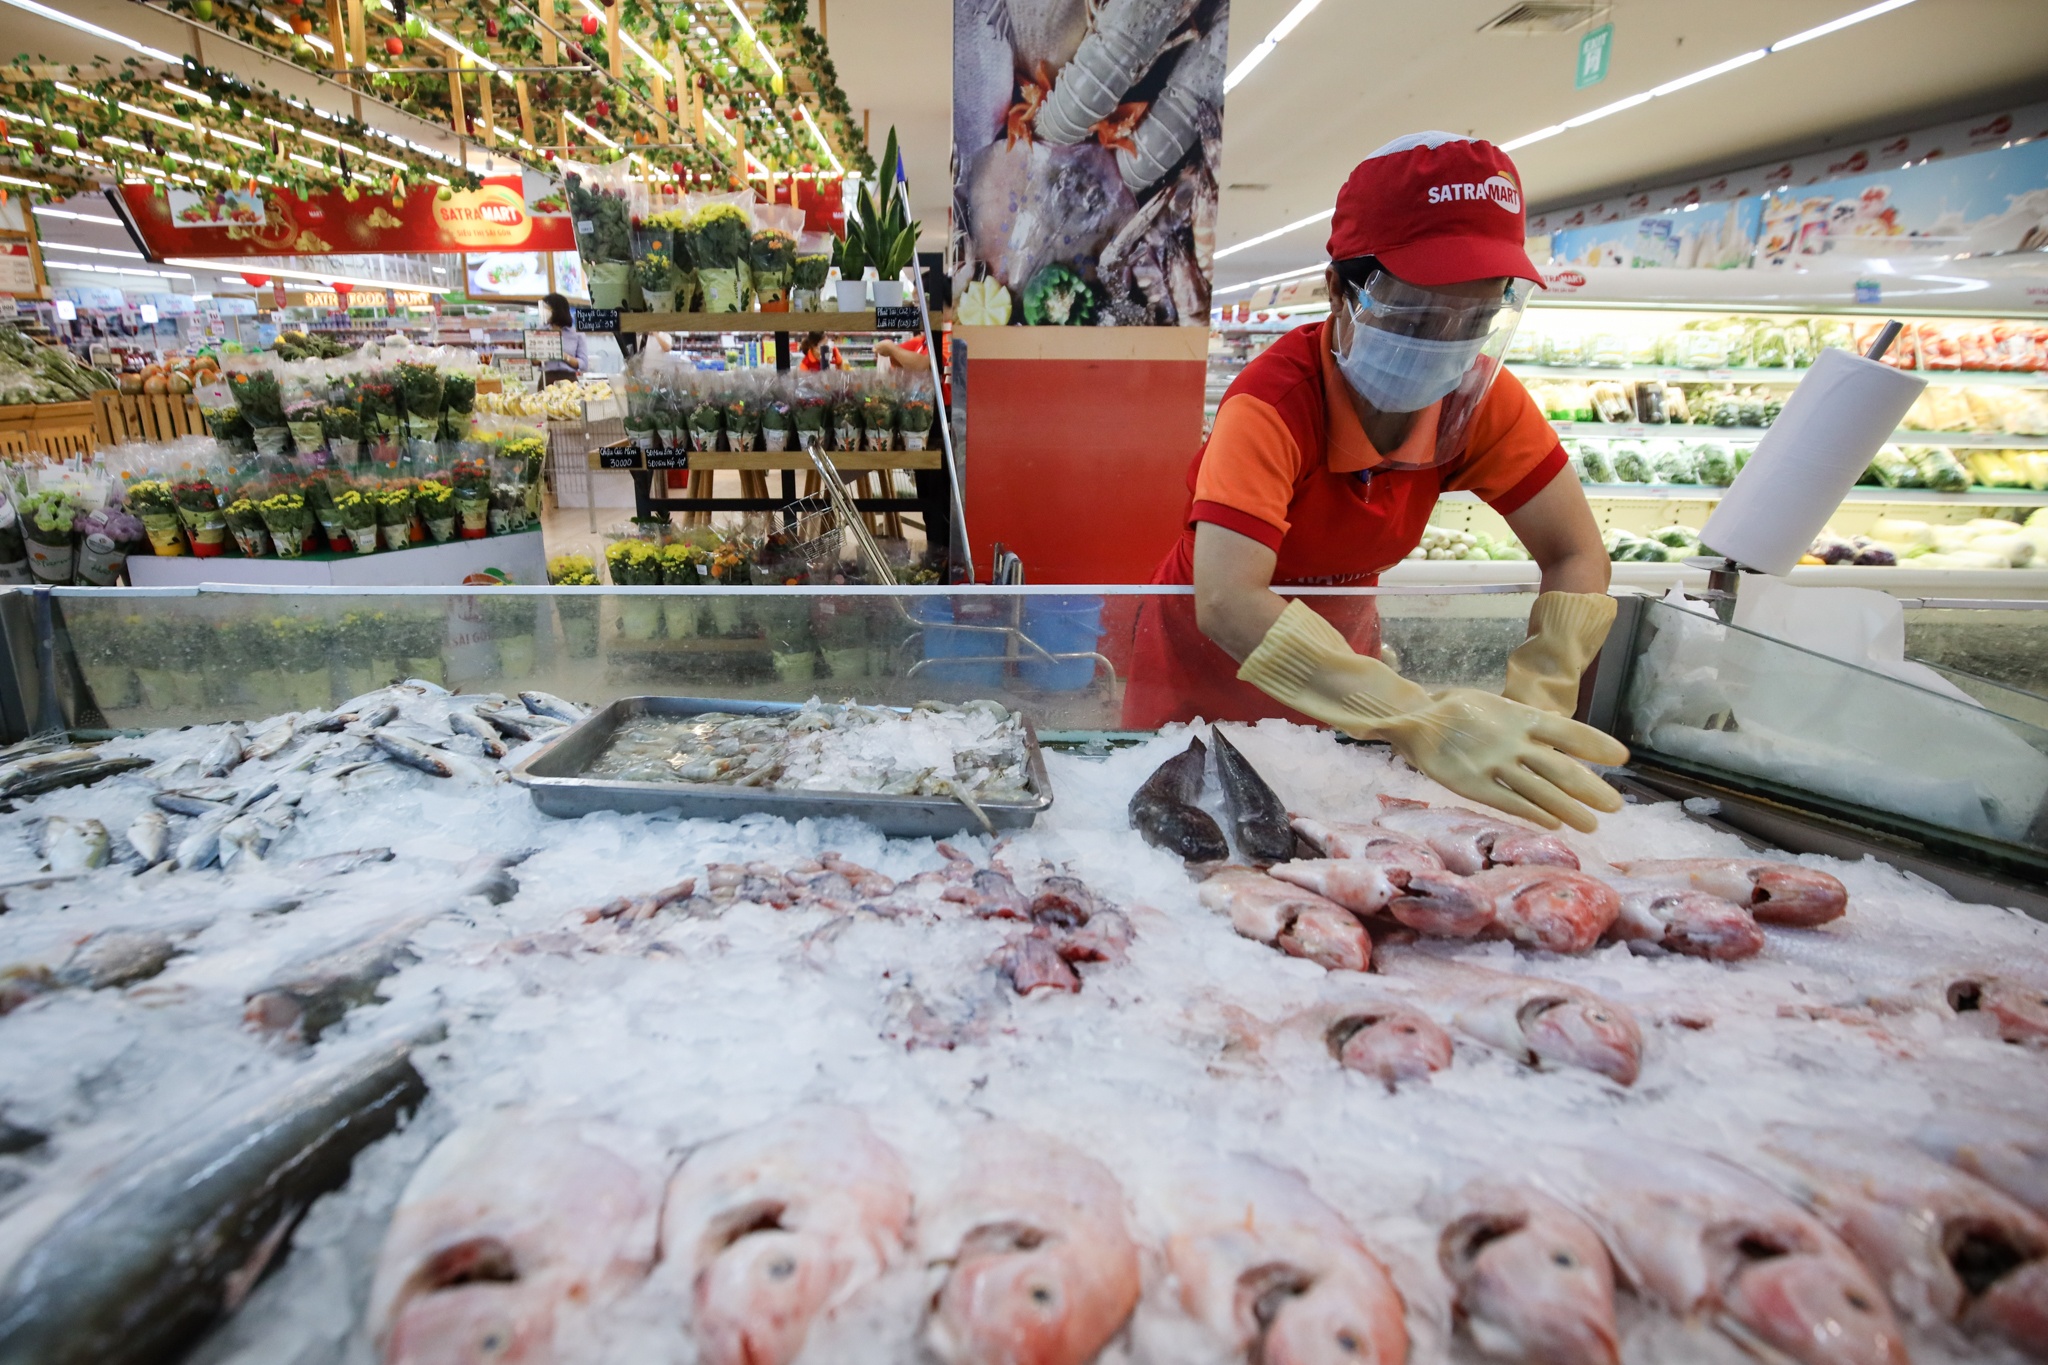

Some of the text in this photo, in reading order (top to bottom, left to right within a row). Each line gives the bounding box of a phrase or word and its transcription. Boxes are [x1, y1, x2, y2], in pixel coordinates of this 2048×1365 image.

[1428, 182, 1518, 206] SATRAMART
[440, 205, 518, 222] SATRAMART
[393, 292, 431, 306] OURT
